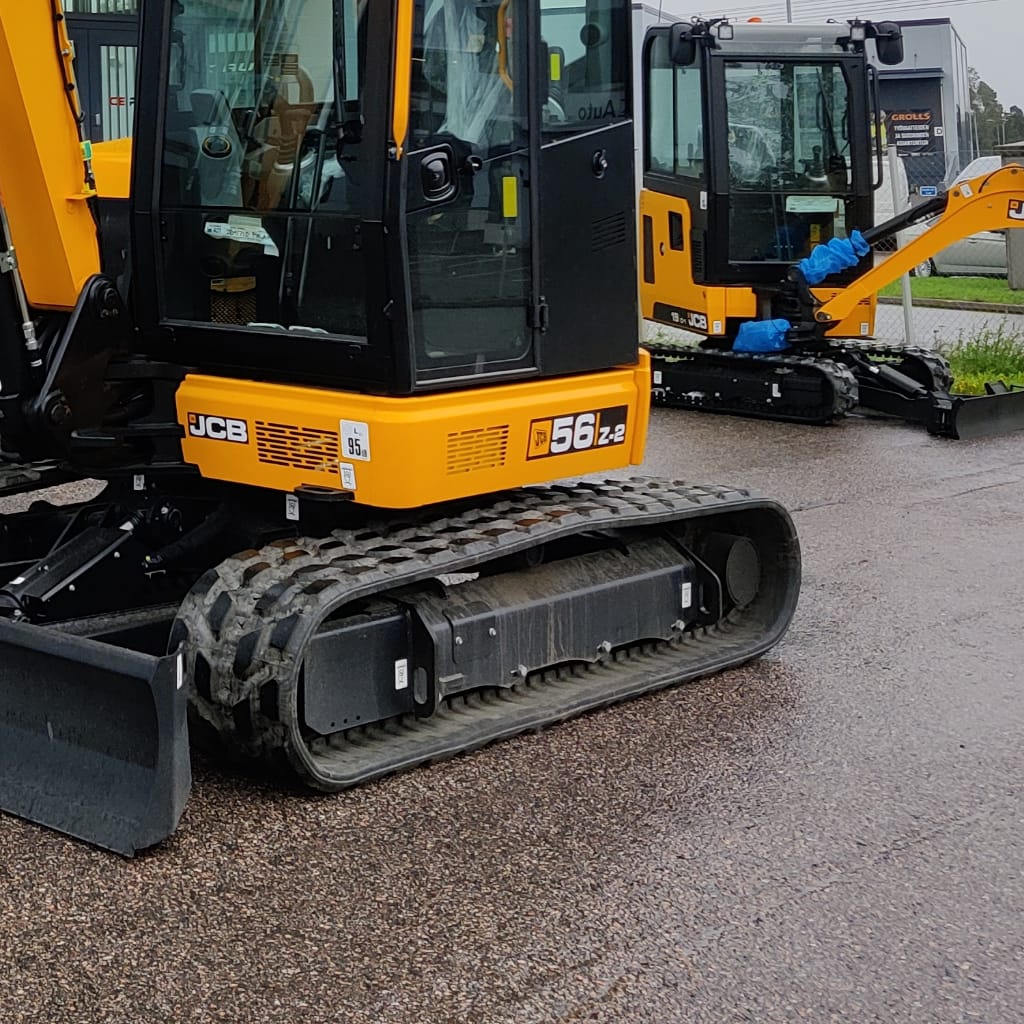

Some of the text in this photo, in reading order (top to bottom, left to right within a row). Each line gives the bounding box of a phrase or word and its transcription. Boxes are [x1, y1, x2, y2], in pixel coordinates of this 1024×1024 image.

[891, 112, 931, 121] GROLLS
[189, 415, 248, 442] JCB
[550, 413, 595, 454] 56
[348, 437, 361, 456] 95
